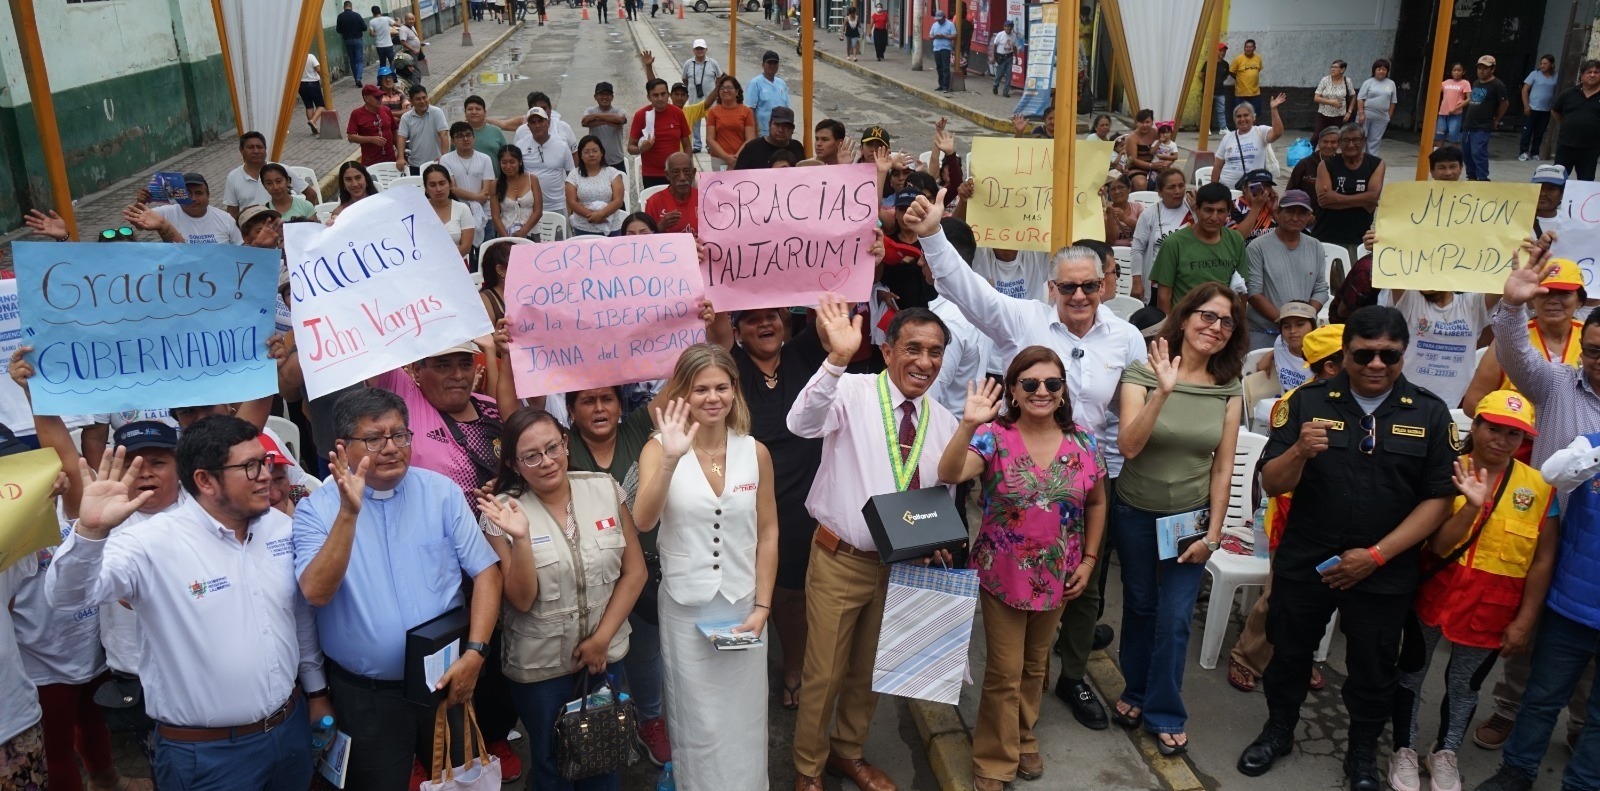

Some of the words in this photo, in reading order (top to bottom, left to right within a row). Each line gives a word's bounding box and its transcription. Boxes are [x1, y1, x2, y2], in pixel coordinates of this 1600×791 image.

[534, 242, 677, 273] GRACIAS
[516, 275, 692, 306] GOBERNADORA
[303, 315, 366, 361] John
[361, 295, 443, 338] Vargas
[545, 313, 564, 331] la
[576, 301, 688, 330] LIBERTAD
[521, 345, 584, 373] JOANA
[630, 328, 706, 357] ROSARIO
[426, 432, 449, 444] adidas
